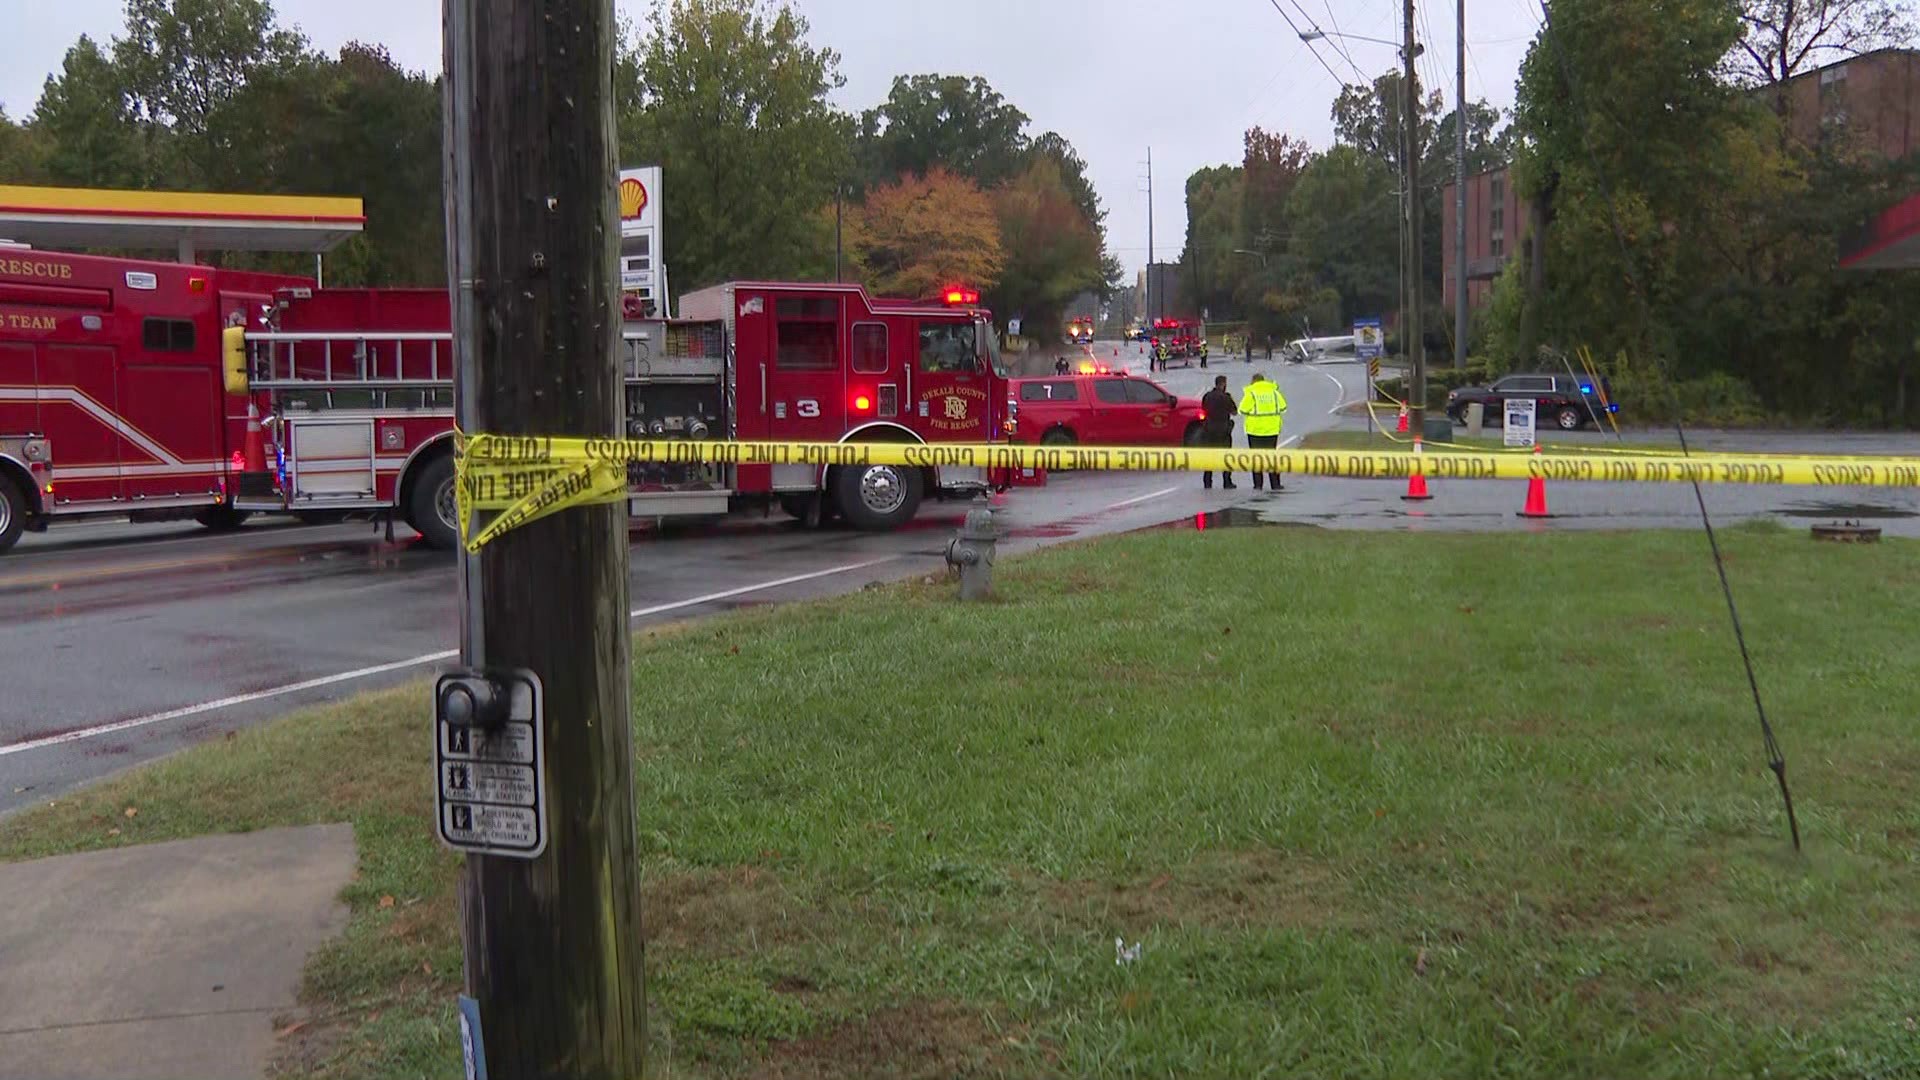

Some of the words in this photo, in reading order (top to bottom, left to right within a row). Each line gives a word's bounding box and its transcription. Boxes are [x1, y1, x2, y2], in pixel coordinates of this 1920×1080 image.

[0, 259, 72, 278] RESCUE
[9, 314, 56, 330] TEAM
[922, 386, 955, 401] DEKALB
[956, 386, 988, 401] COUNTY
[1043, 385, 1052, 399] 7
[797, 399, 821, 418] 3
[930, 418, 949, 430] FIRE
[950, 417, 980, 431] RESCUE
